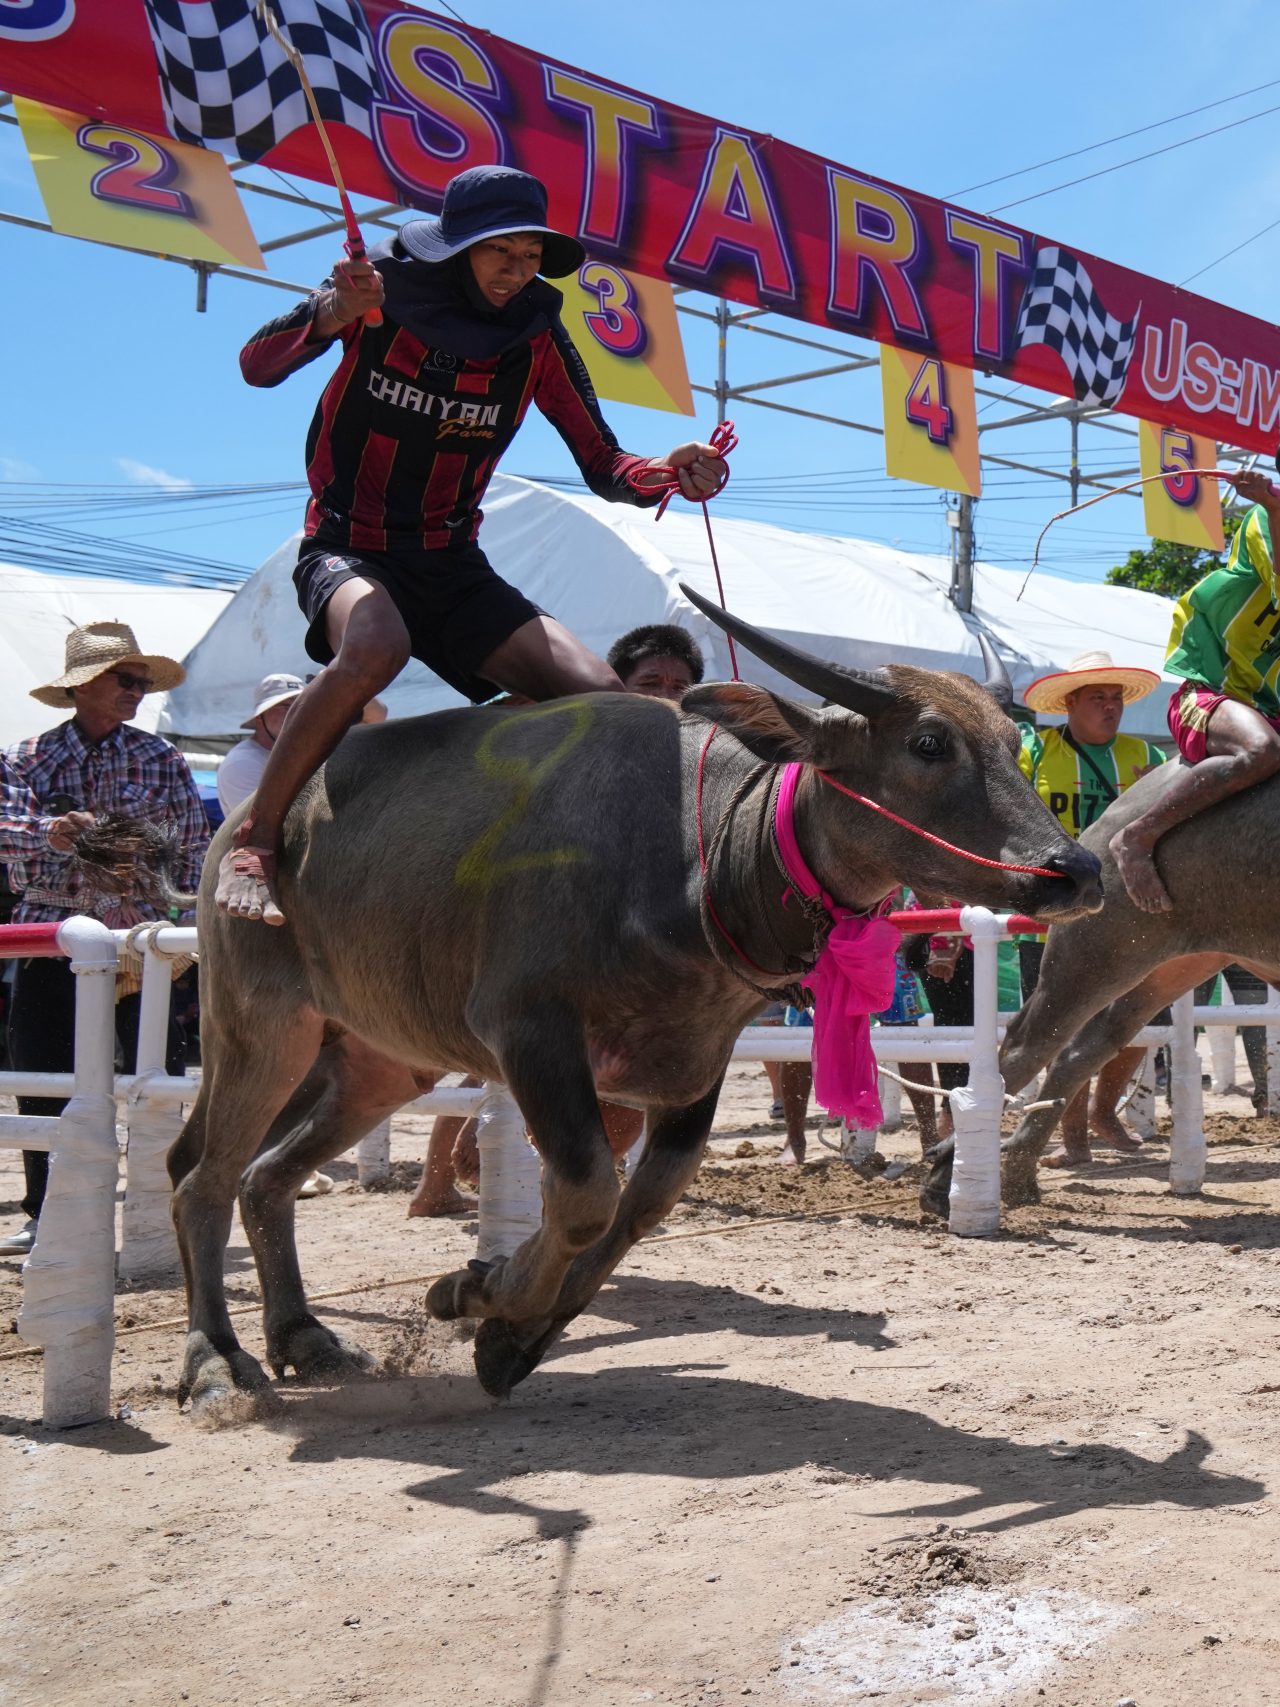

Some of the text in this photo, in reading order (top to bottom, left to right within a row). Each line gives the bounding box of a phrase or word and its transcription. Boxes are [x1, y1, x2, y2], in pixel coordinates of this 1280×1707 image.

[76, 122, 196, 219] 2
[371, 11, 1026, 361] START
[579, 260, 648, 358] 3
[366, 369, 502, 428] CHAIYAN
[435, 417, 497, 440] Farm
[906, 358, 953, 443] 4
[1160, 430, 1199, 507] 5
[1050, 792, 1117, 829] PIZ
